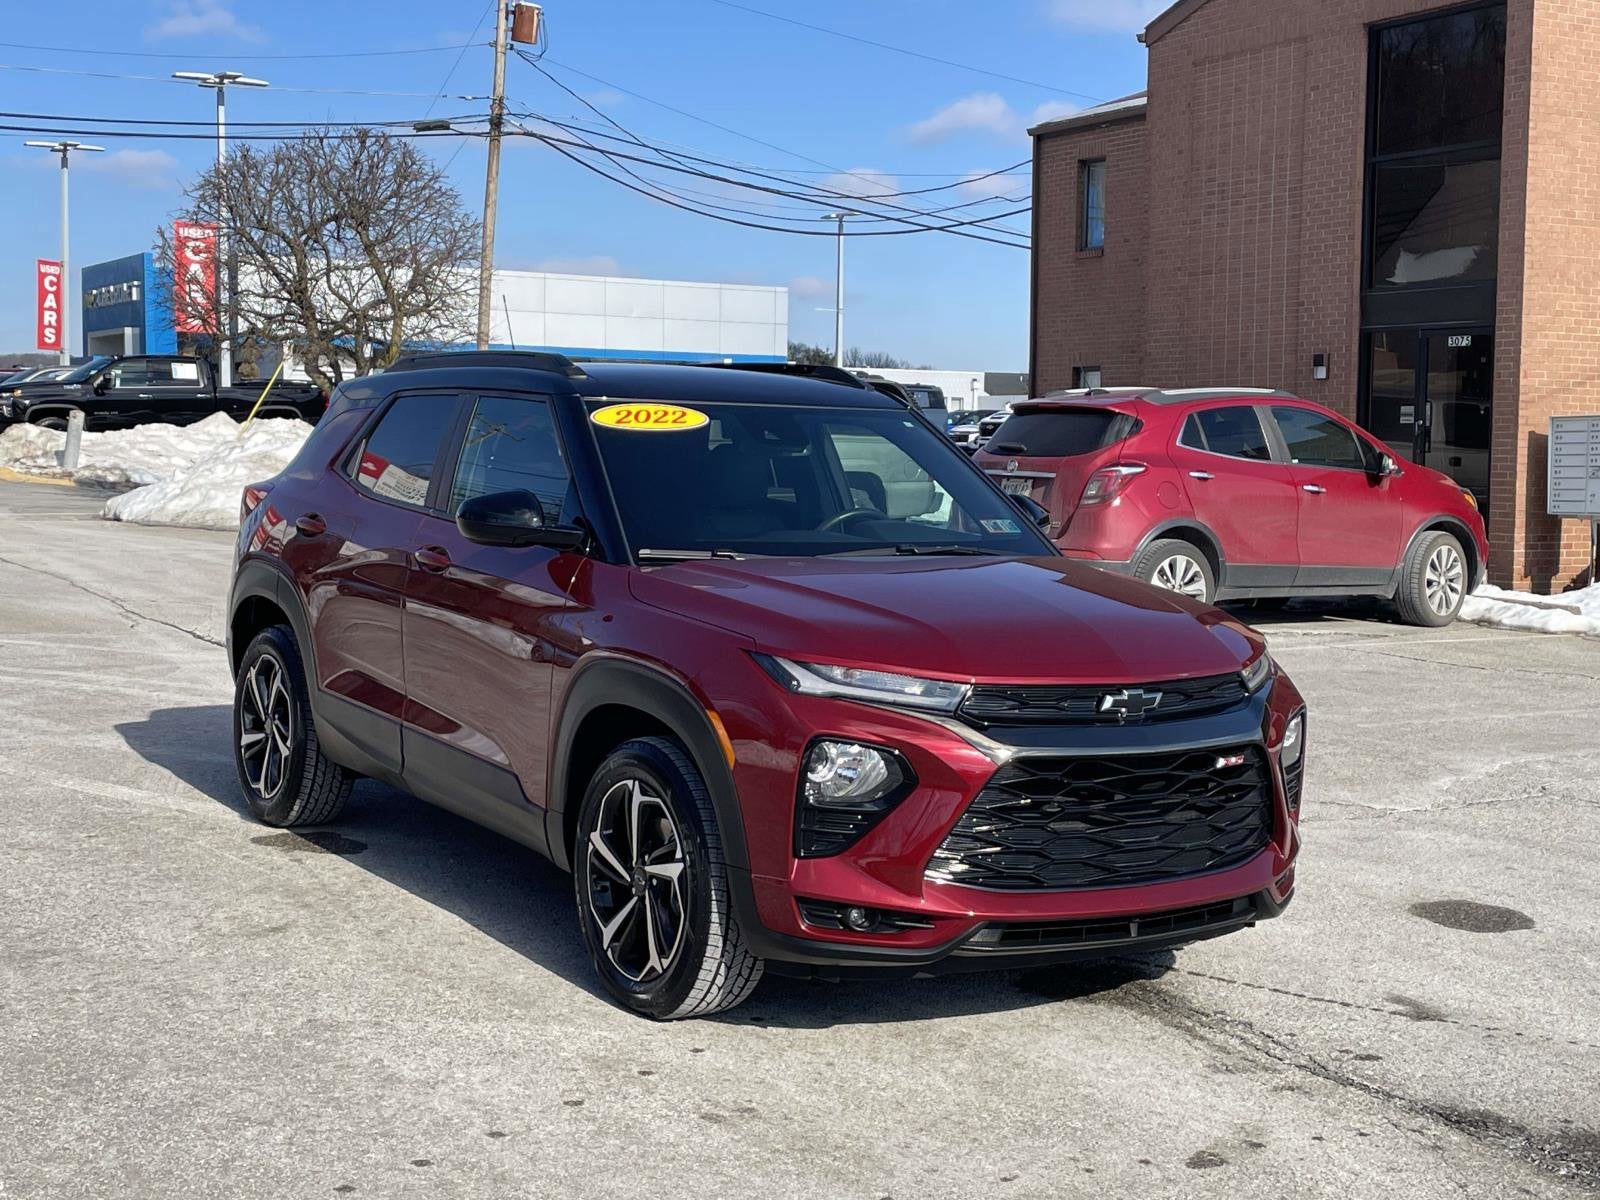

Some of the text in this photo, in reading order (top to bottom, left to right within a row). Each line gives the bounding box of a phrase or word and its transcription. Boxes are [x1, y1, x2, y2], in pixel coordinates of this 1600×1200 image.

[39, 263, 61, 275] USED
[43, 275, 58, 344] CARS
[1448, 336, 1471, 346] 3075
[615, 409, 687, 424] 2022
